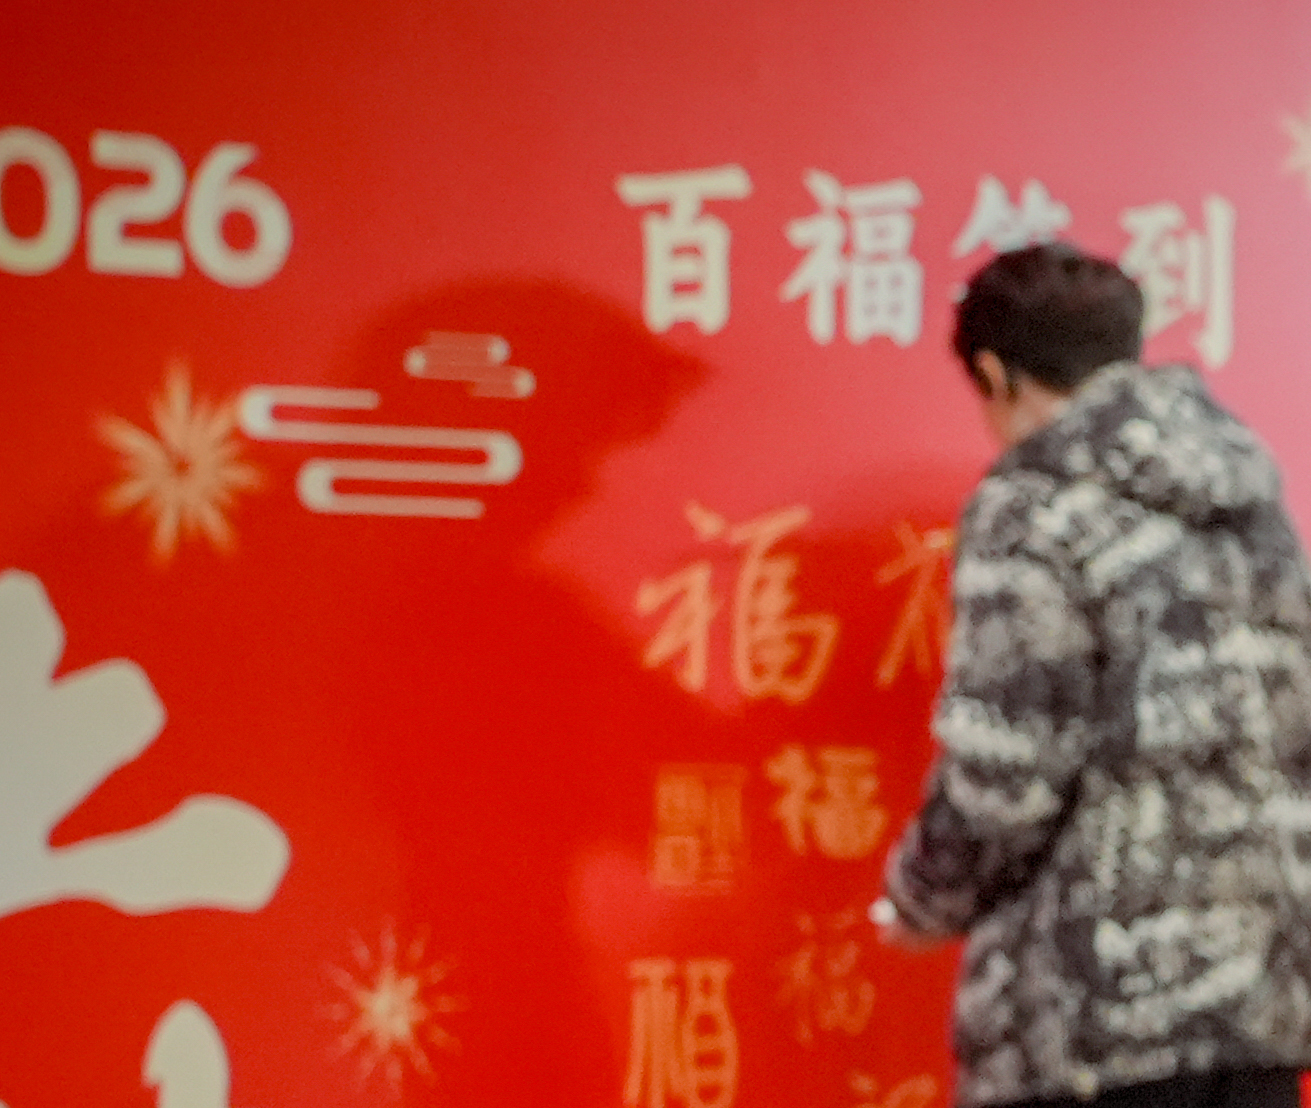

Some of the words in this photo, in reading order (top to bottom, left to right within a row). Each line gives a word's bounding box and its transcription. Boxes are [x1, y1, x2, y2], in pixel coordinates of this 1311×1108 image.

[0, 126, 293, 289] 026
[636, 501, 842, 703] 福
[763, 744, 888, 860] 福
